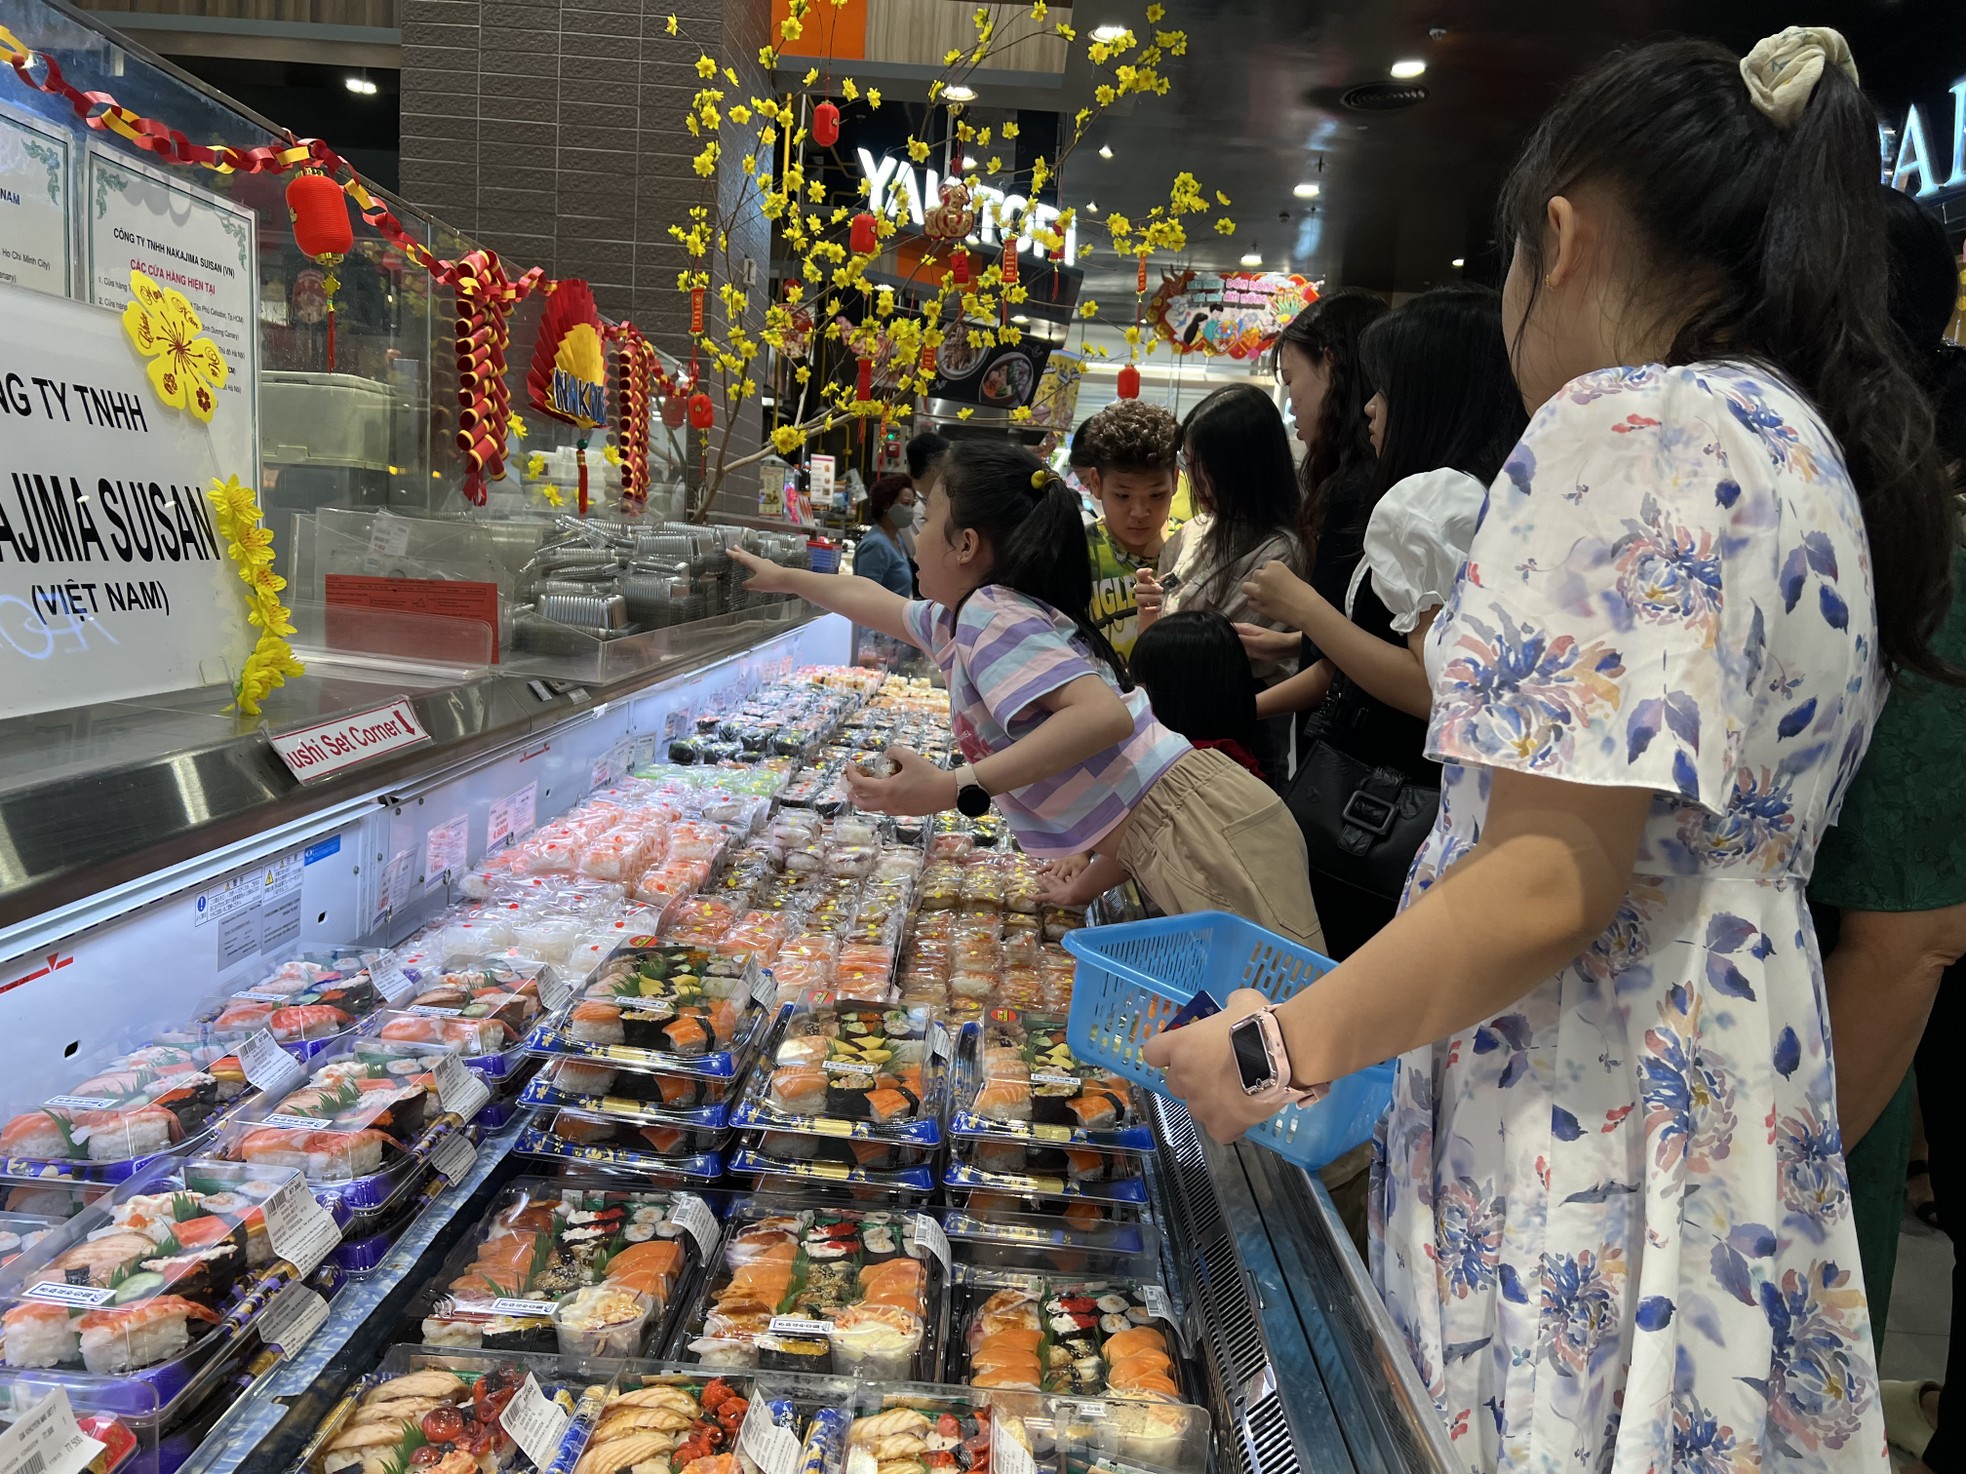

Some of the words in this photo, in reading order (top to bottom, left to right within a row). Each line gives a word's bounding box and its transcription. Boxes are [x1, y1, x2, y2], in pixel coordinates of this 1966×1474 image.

[113, 227, 135, 244] CÔNG
[136, 234, 145, 248] TY
[146, 239, 164, 254] TNHH
[166, 245, 199, 266] NAKAJIMA
[199, 257, 222, 274] SUISAN
[223, 265, 235, 279] (VN)
[148, 264, 164, 279] CỬA
[166, 269, 186, 285] HÀNG
[187, 276, 203, 293] HIỆN
[205, 282, 215, 297] TẠI
[31, 376, 71, 422] TY
[72, 384, 148, 433] TNHH
[97, 478, 221, 564] SUISAN
[31, 578, 101, 626] (VIỆT
[104, 580, 170, 617] NAM)
[320, 730, 358, 756] Set
[348, 719, 403, 748] Corner
